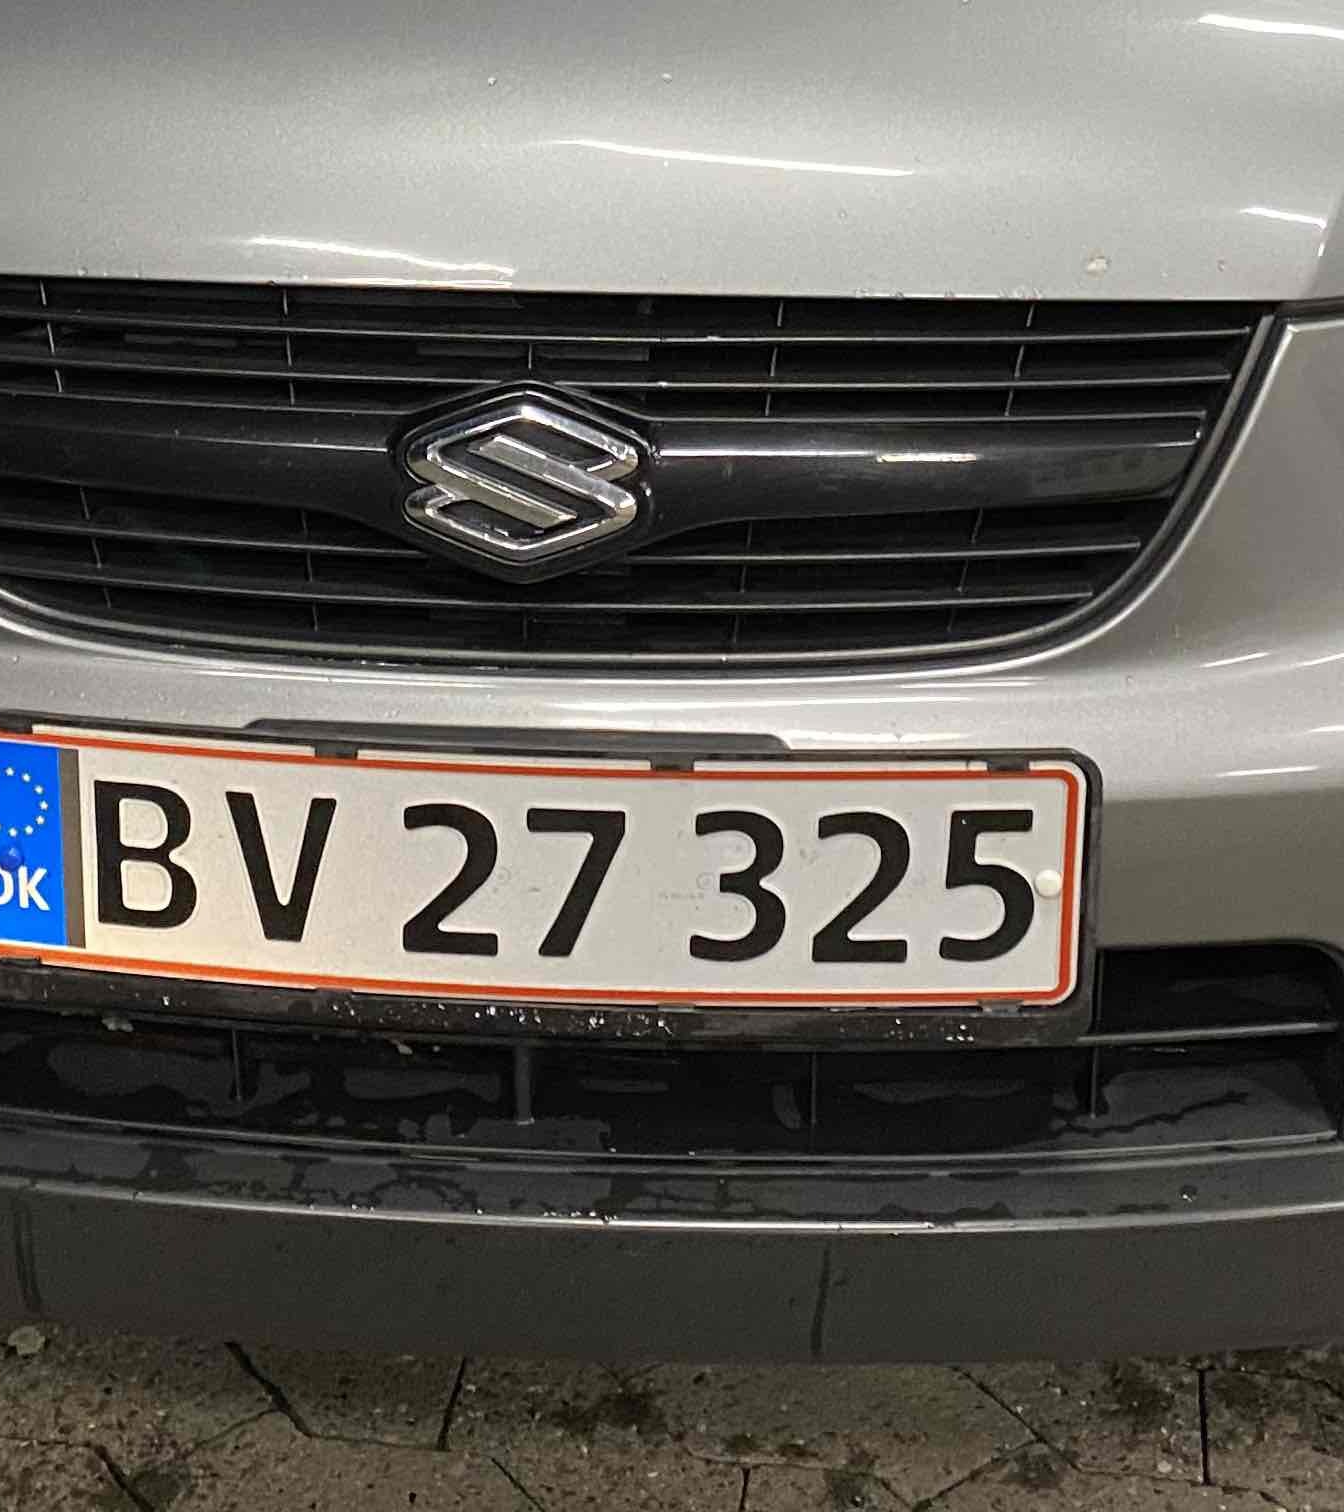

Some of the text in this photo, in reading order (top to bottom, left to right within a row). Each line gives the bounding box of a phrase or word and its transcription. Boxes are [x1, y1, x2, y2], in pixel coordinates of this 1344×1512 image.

[92, 777, 1039, 964] BV 27 325
